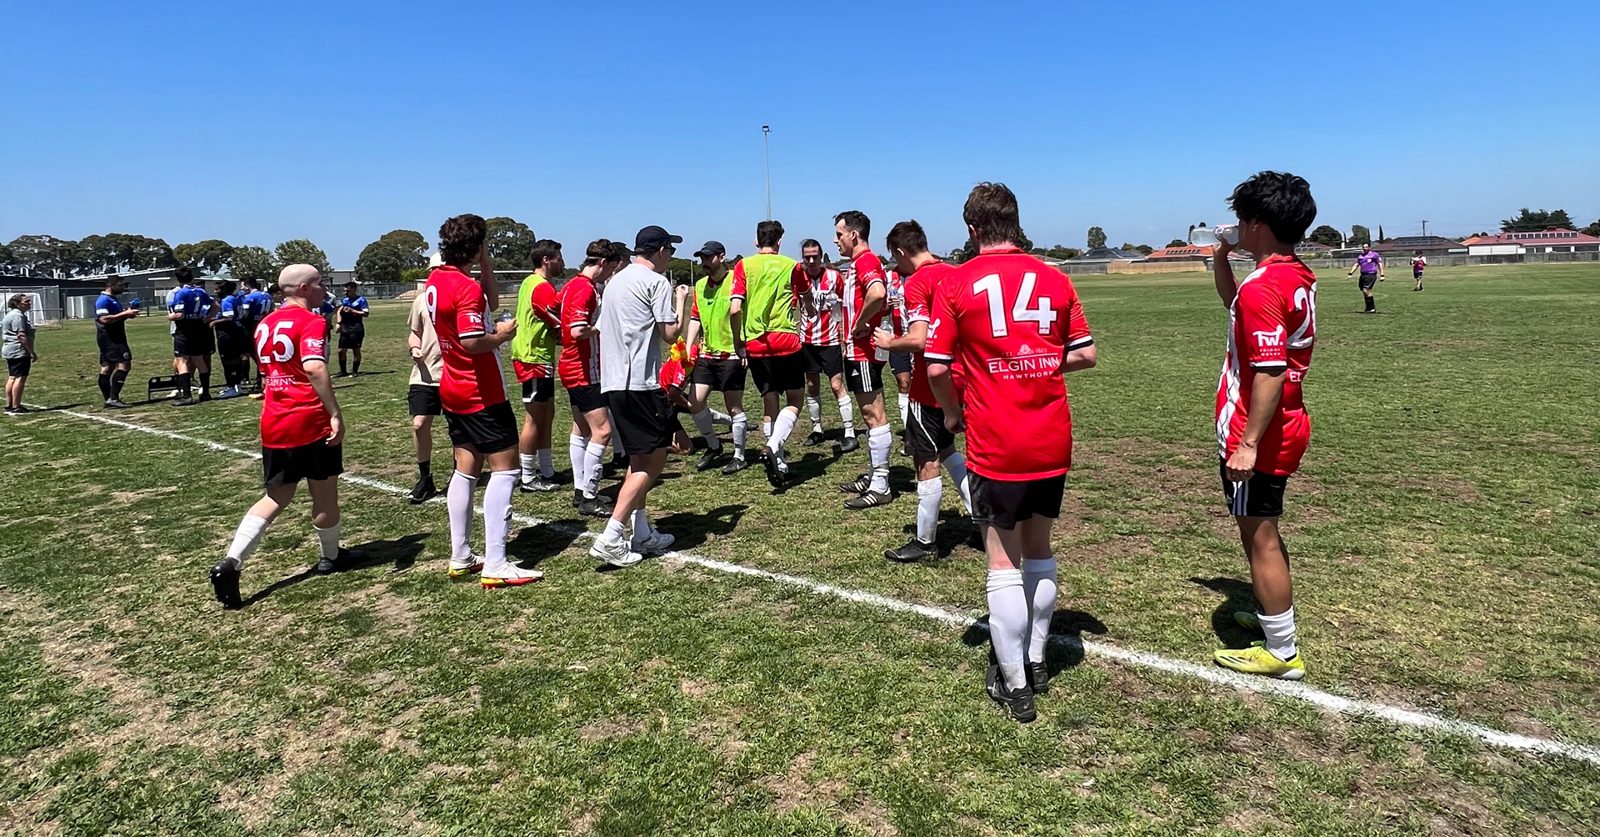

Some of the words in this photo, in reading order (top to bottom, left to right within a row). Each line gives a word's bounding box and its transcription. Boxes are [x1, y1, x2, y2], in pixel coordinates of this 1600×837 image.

[973, 272, 1057, 338] 14
[254, 321, 294, 363] 25
[988, 359, 1036, 374] ELGIN
[1039, 357, 1060, 369] INN
